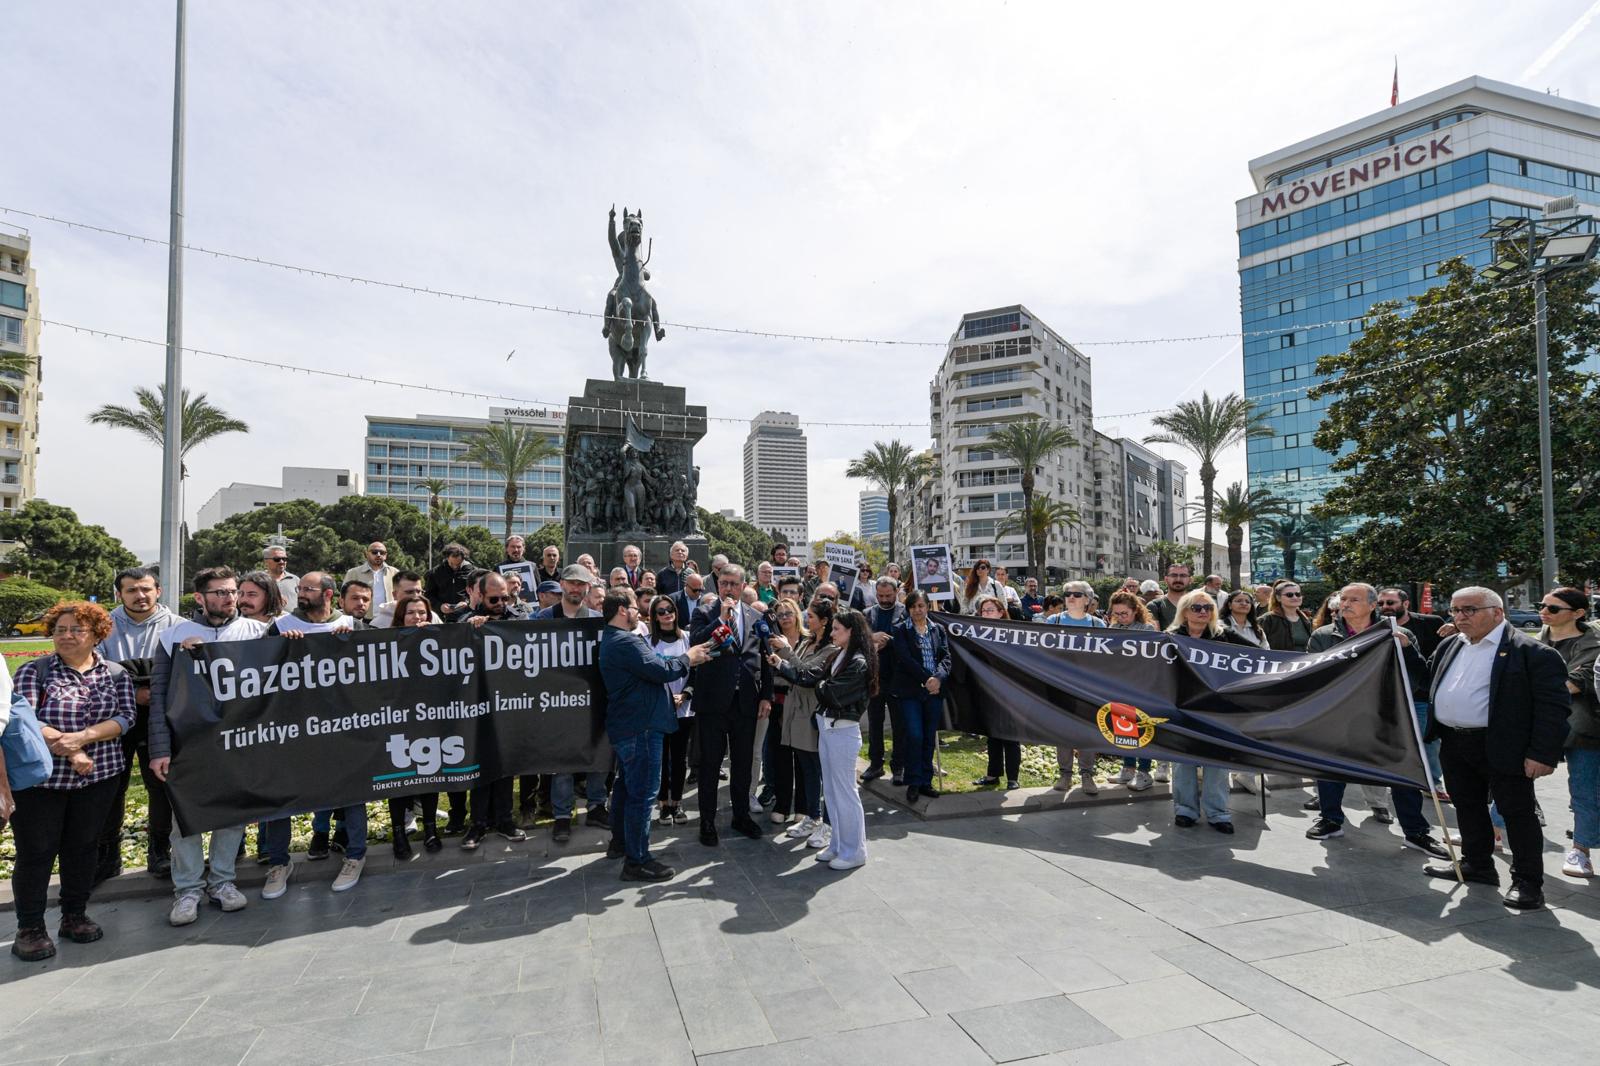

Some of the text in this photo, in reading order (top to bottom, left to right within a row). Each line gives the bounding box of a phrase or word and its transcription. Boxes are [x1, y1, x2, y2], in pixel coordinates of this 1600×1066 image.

[504, 406, 547, 418] swissôtel
[948, 622, 1114, 655] GAZETECİLİK
[1121, 639, 1179, 664] SUÇ
[194, 641, 410, 701] "Gazetecilik
[420, 638, 475, 685] Suç
[221, 690, 591, 750] Türkiye Gazeteciler Sendikası İzmir Şubesi
[1115, 735, 1138, 746] İZMİR
[386, 733, 466, 775] tgs
[372, 772, 480, 791] TÜRKİYE GAZETECİLER SENDİKASI
